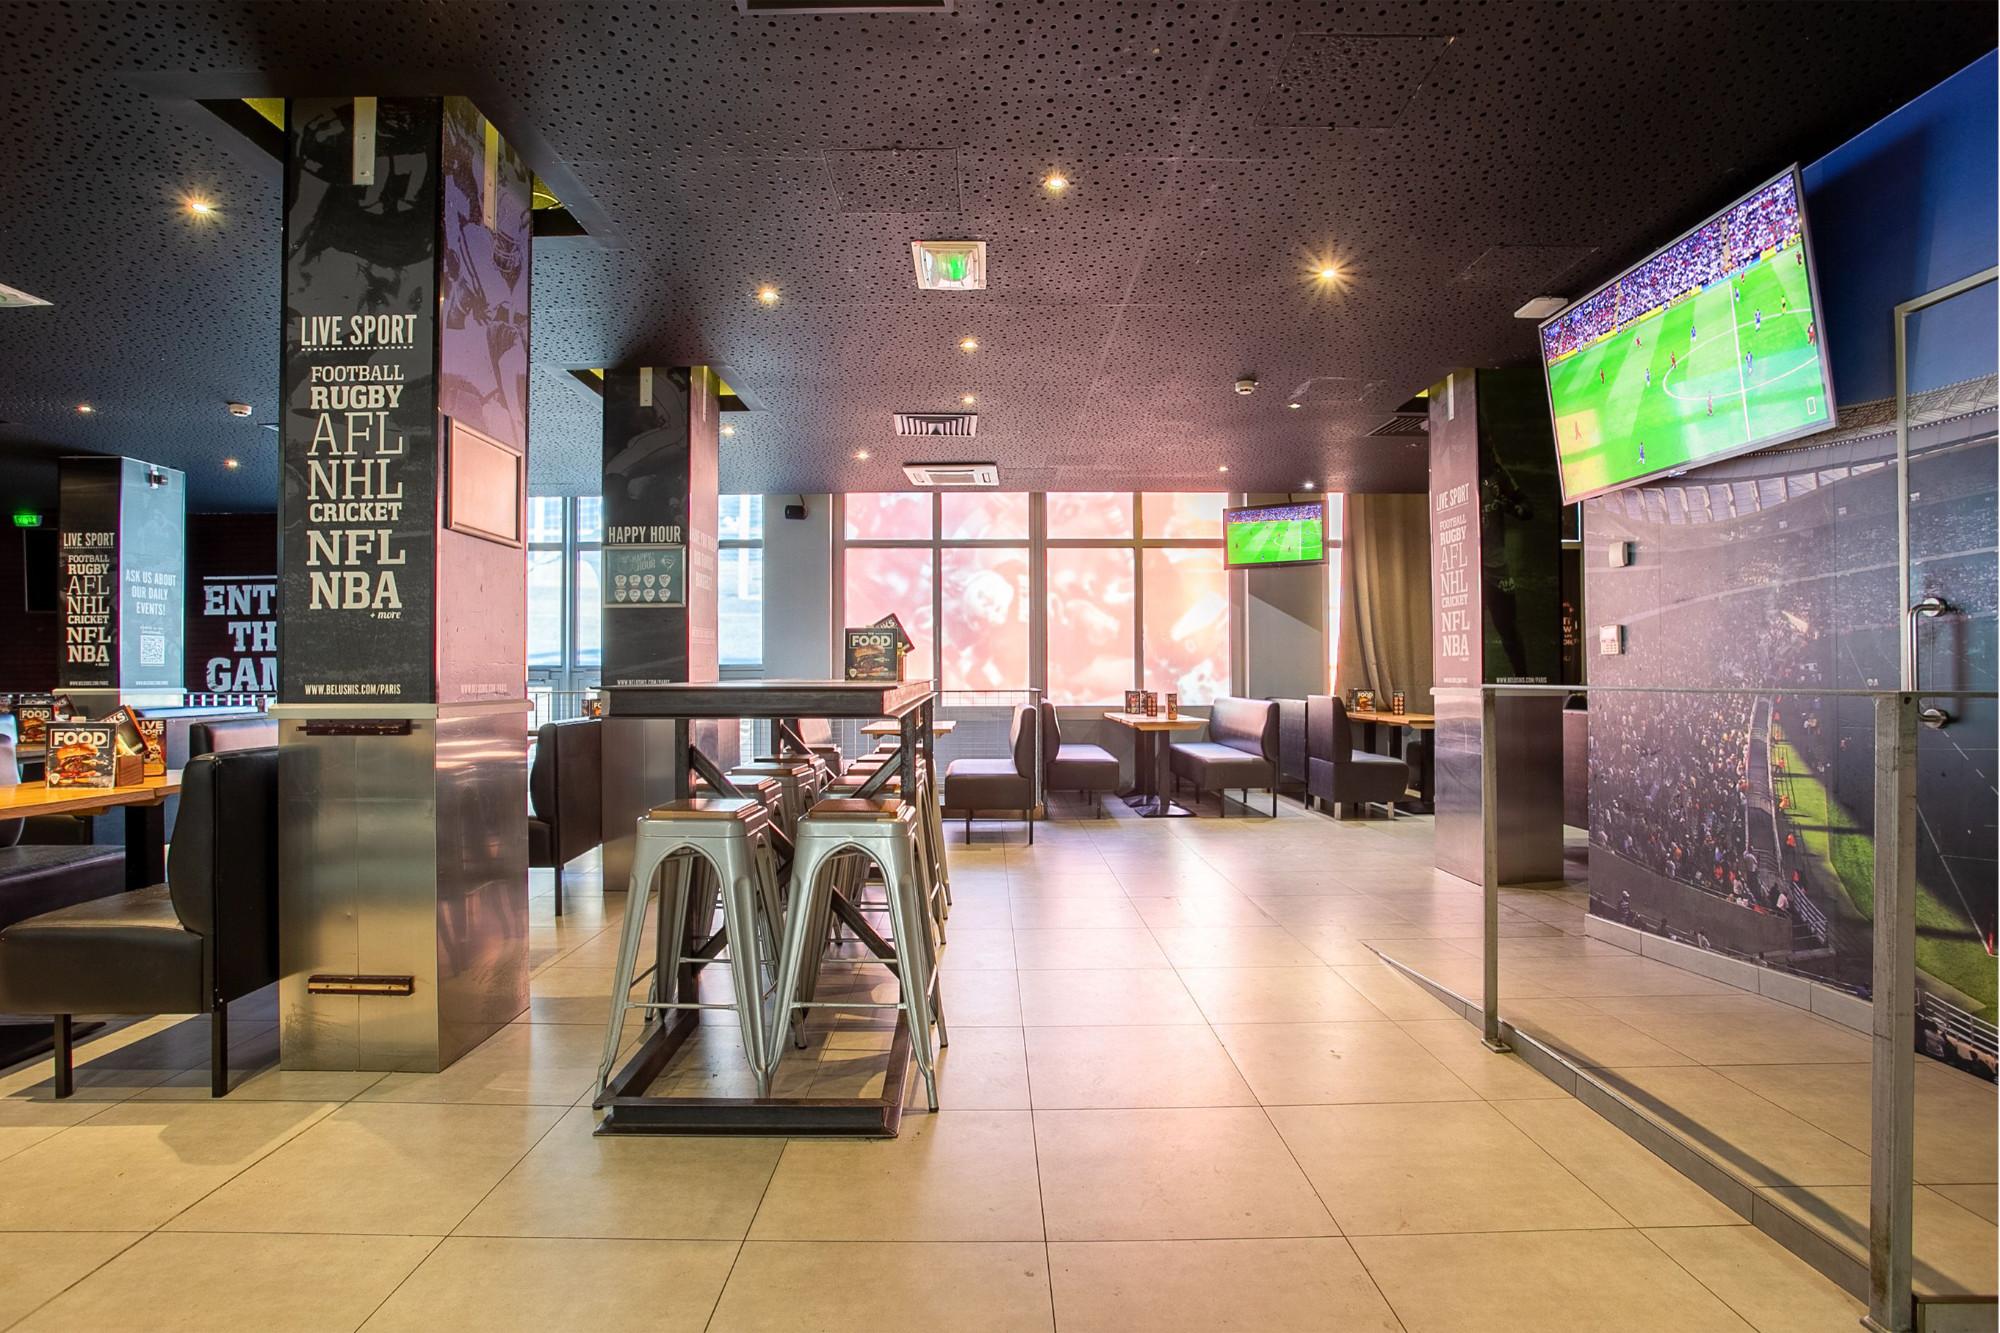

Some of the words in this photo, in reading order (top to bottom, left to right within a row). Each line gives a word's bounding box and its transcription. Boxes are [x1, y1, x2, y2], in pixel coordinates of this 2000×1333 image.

[301, 316, 343, 346] LIVE
[350, 314, 417, 345] SPORT
[311, 365, 404, 382] FOOTBALL
[310, 385, 403, 409] RUGBY
[307, 411, 403, 456] AFL
[307, 458, 403, 500] NHL
[1436, 491, 1449, 511] LIVE
[1450, 483, 1469, 507] SPORT
[309, 502, 402, 523] CRICKET
[63, 532, 82, 547] LIVE
[85, 532, 115, 546] SPORT
[608, 526, 646, 543] HAPPY
[650, 525, 681, 543] HOUR
[1440, 525, 1467, 546] RUGBY
[306, 529, 406, 566] NFL
[68, 555, 110, 563] FOOTBALL
[1440, 542, 1468, 572] AFL
[68, 563, 110, 575] RUGBY
[125, 570, 141, 583] ASK
[142, 571, 153, 584] US
[154, 573, 176, 586] ABOUT
[67, 575, 110, 595] AFL
[309, 570, 402, 610] NBA
[1440, 569, 1468, 596] NHL
[131, 585, 147, 598] OUR
[148, 587, 168, 600] DAILY
[203, 584, 277, 616] ENT
[66, 596, 110, 614] NHL
[136, 601, 166, 616] EVENTS!
[68, 615, 110, 625] CRICKET
[377, 611, 401, 619] more
[1441, 609, 1470, 632] NFL
[66, 626, 111, 643] NFL
[228, 621, 277, 652] TH
[851, 635, 891, 647] FOOD
[68, 645, 110, 663] NBA
[1442, 634, 1469, 656] NBA
[304, 683, 401, 695] WWW.BELUSHIS.COM/PARIS
[21, 710, 50, 719] FOOD
[141, 720, 164, 730] IVE
[54, 732, 107, 746] FOOD
